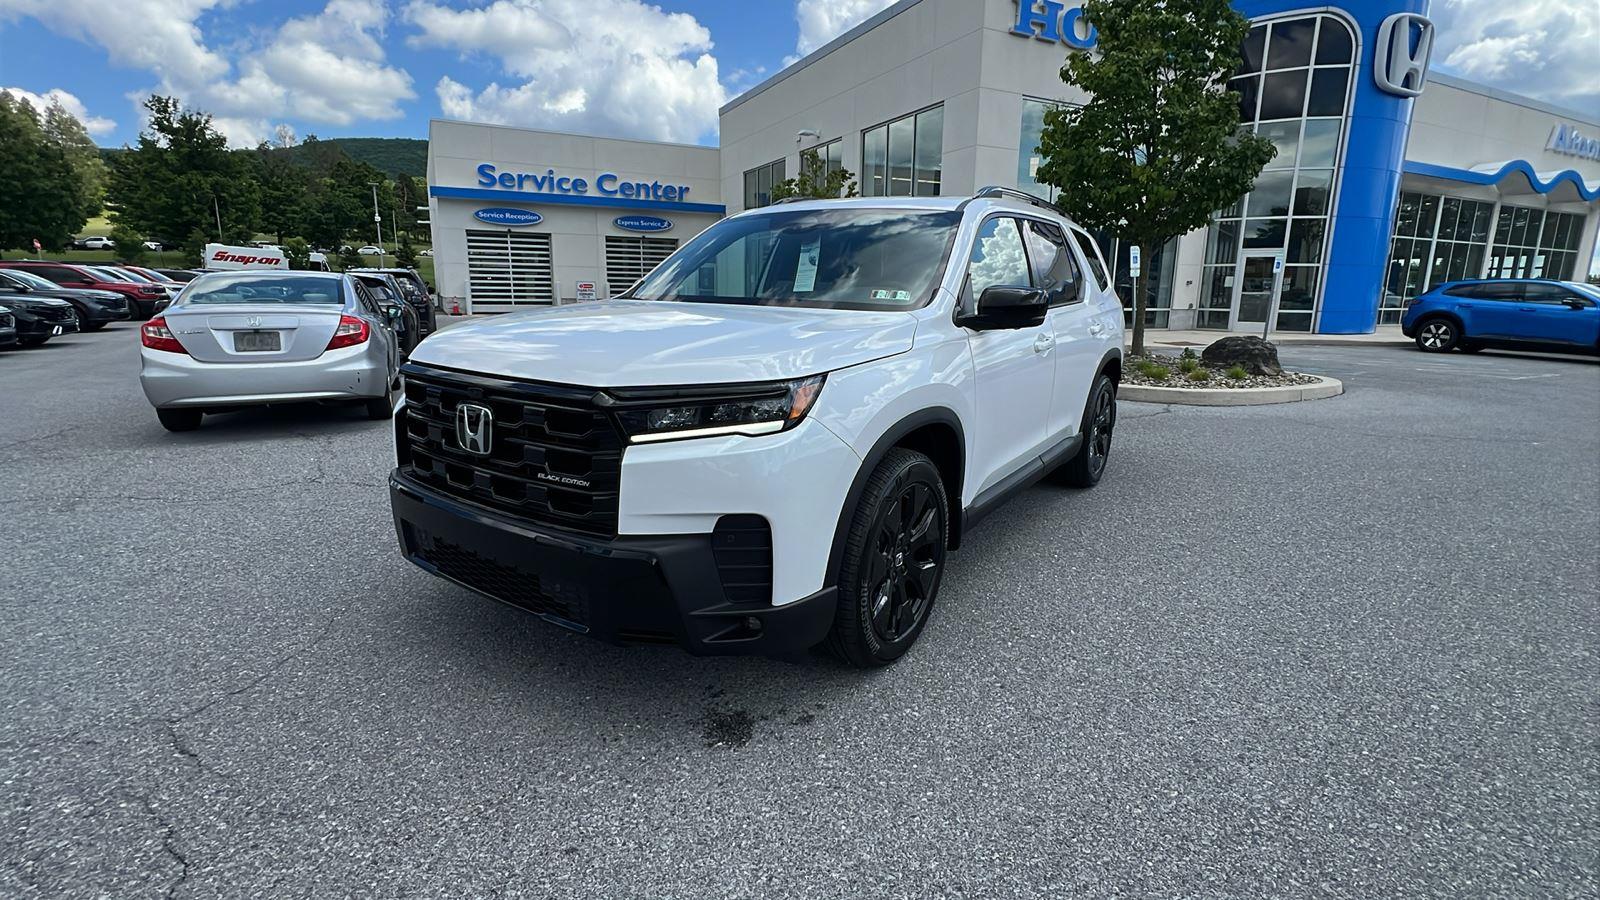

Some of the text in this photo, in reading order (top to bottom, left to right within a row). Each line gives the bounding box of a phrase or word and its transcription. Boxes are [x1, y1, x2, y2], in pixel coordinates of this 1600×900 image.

[477, 163, 690, 201] Service Center
[478, 211, 539, 220] Service Reception
[640, 219, 661, 227] Service
[212, 251, 281, 265] Snap-on
[537, 473, 590, 487] BLACK EDITION
